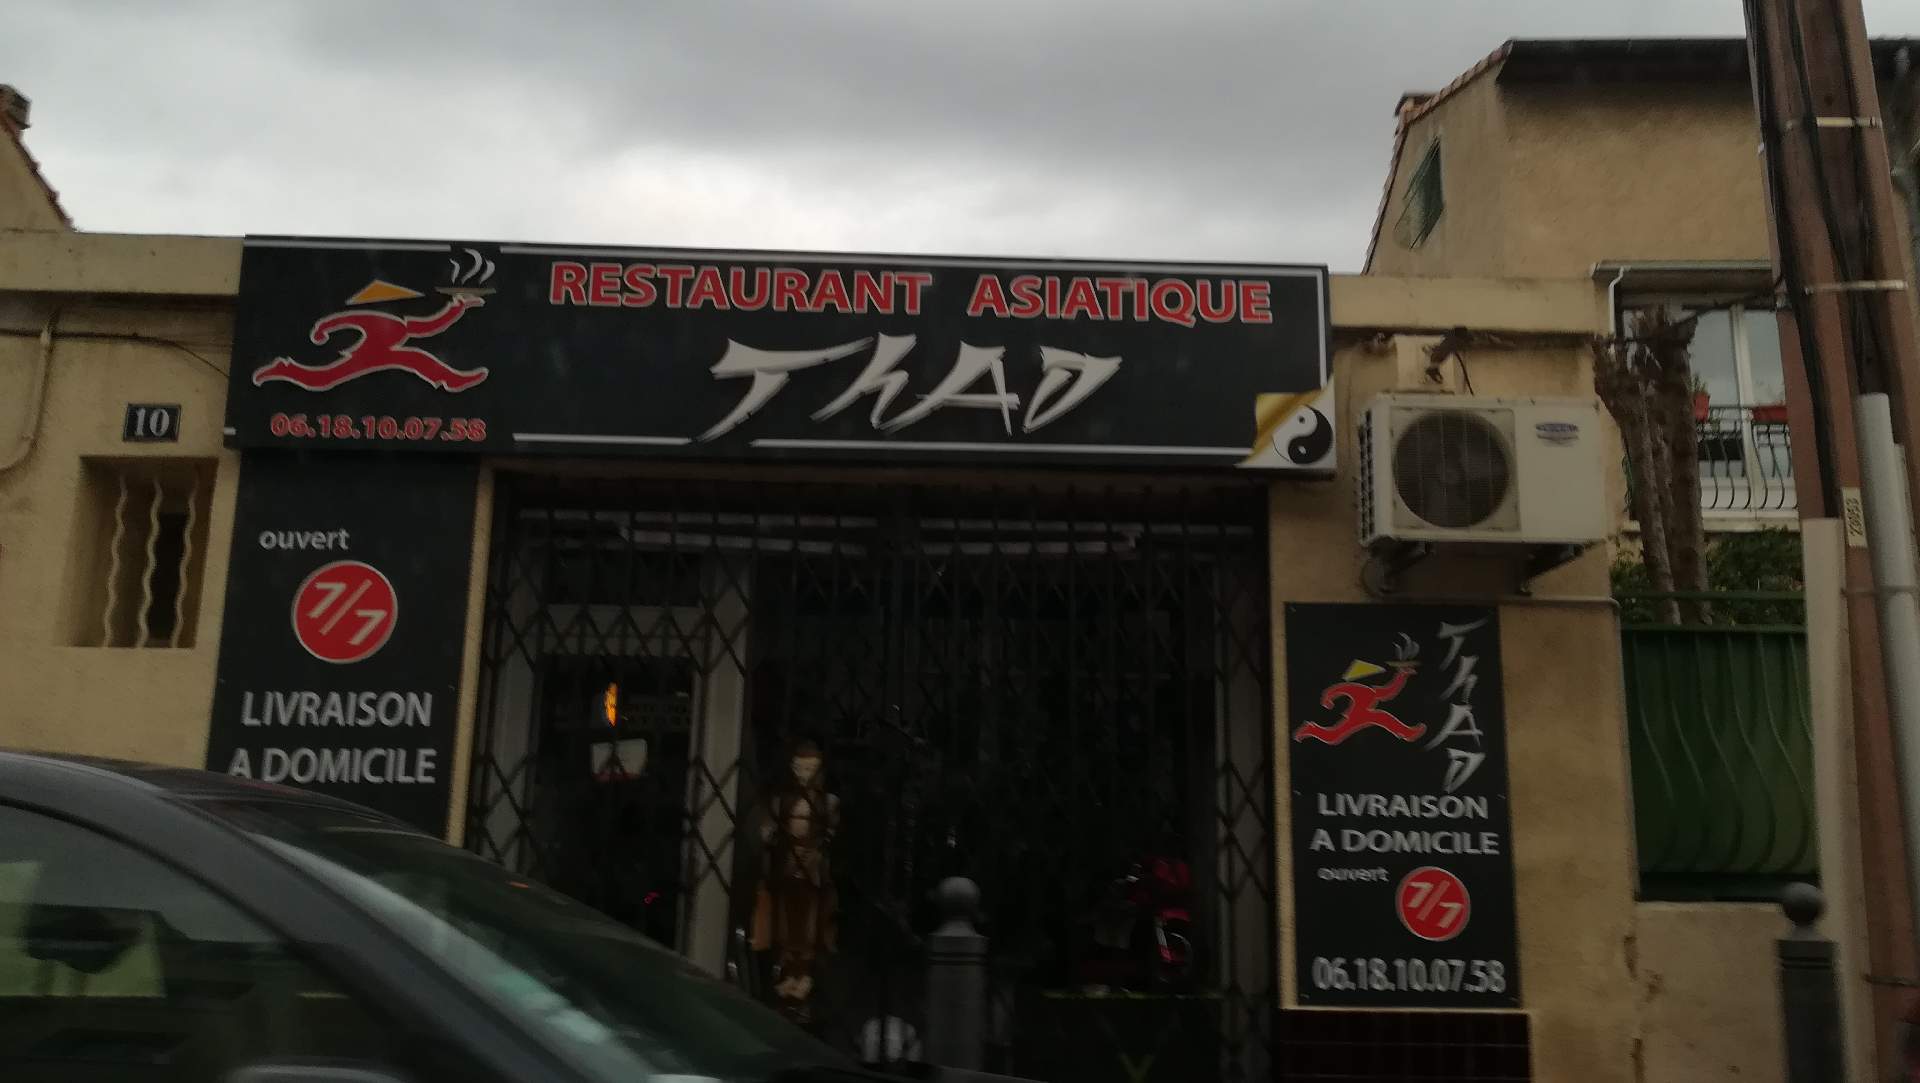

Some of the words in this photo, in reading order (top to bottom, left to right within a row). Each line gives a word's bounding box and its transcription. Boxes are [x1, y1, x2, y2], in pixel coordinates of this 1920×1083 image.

[548, 260, 934, 316] RESTAURANT
[966, 275, 1274, 328] ASIATIQUE
[134, 407, 170, 437] 10
[270, 412, 487, 442] 06.18.10.07.58
[258, 527, 351, 550] ouvert
[307, 578, 388, 646] 7/7
[240, 690, 433, 728] LIVRAISON
[227, 748, 252, 779] A
[260, 748, 438, 784] DOMICILE
[1316, 792, 1489, 820] LIVRAISON
[1309, 828, 1335, 852] A
[1340, 829, 1500, 856] DOMICILE
[1317, 865, 1391, 882] ouvert
[1407, 880, 1465, 930] 7/7
[1311, 955, 1507, 994] 06.18.10.07.58
